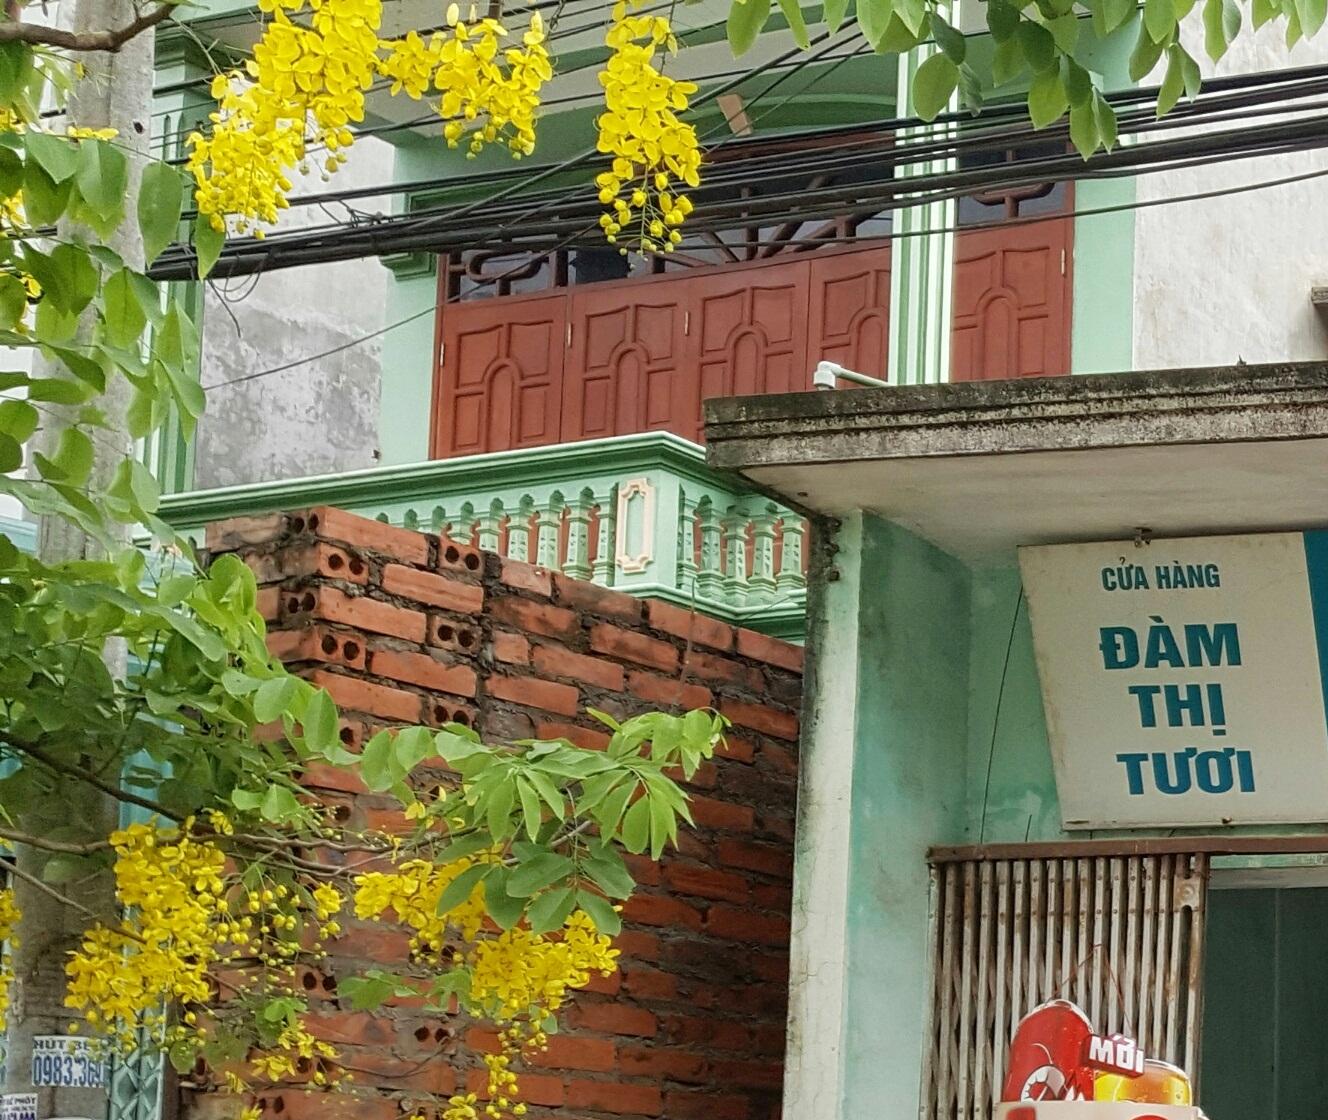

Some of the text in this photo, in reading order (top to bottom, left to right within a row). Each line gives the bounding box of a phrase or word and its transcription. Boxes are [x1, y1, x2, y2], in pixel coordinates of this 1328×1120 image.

[1101, 557, 1221, 591] CỬA HÀNG
[1099, 615, 1242, 670] ĐÀM
[1128, 683, 1227, 736] THỊ
[1116, 747, 1256, 795] TƯƠI
[1089, 1034, 1144, 1073] MỚI
